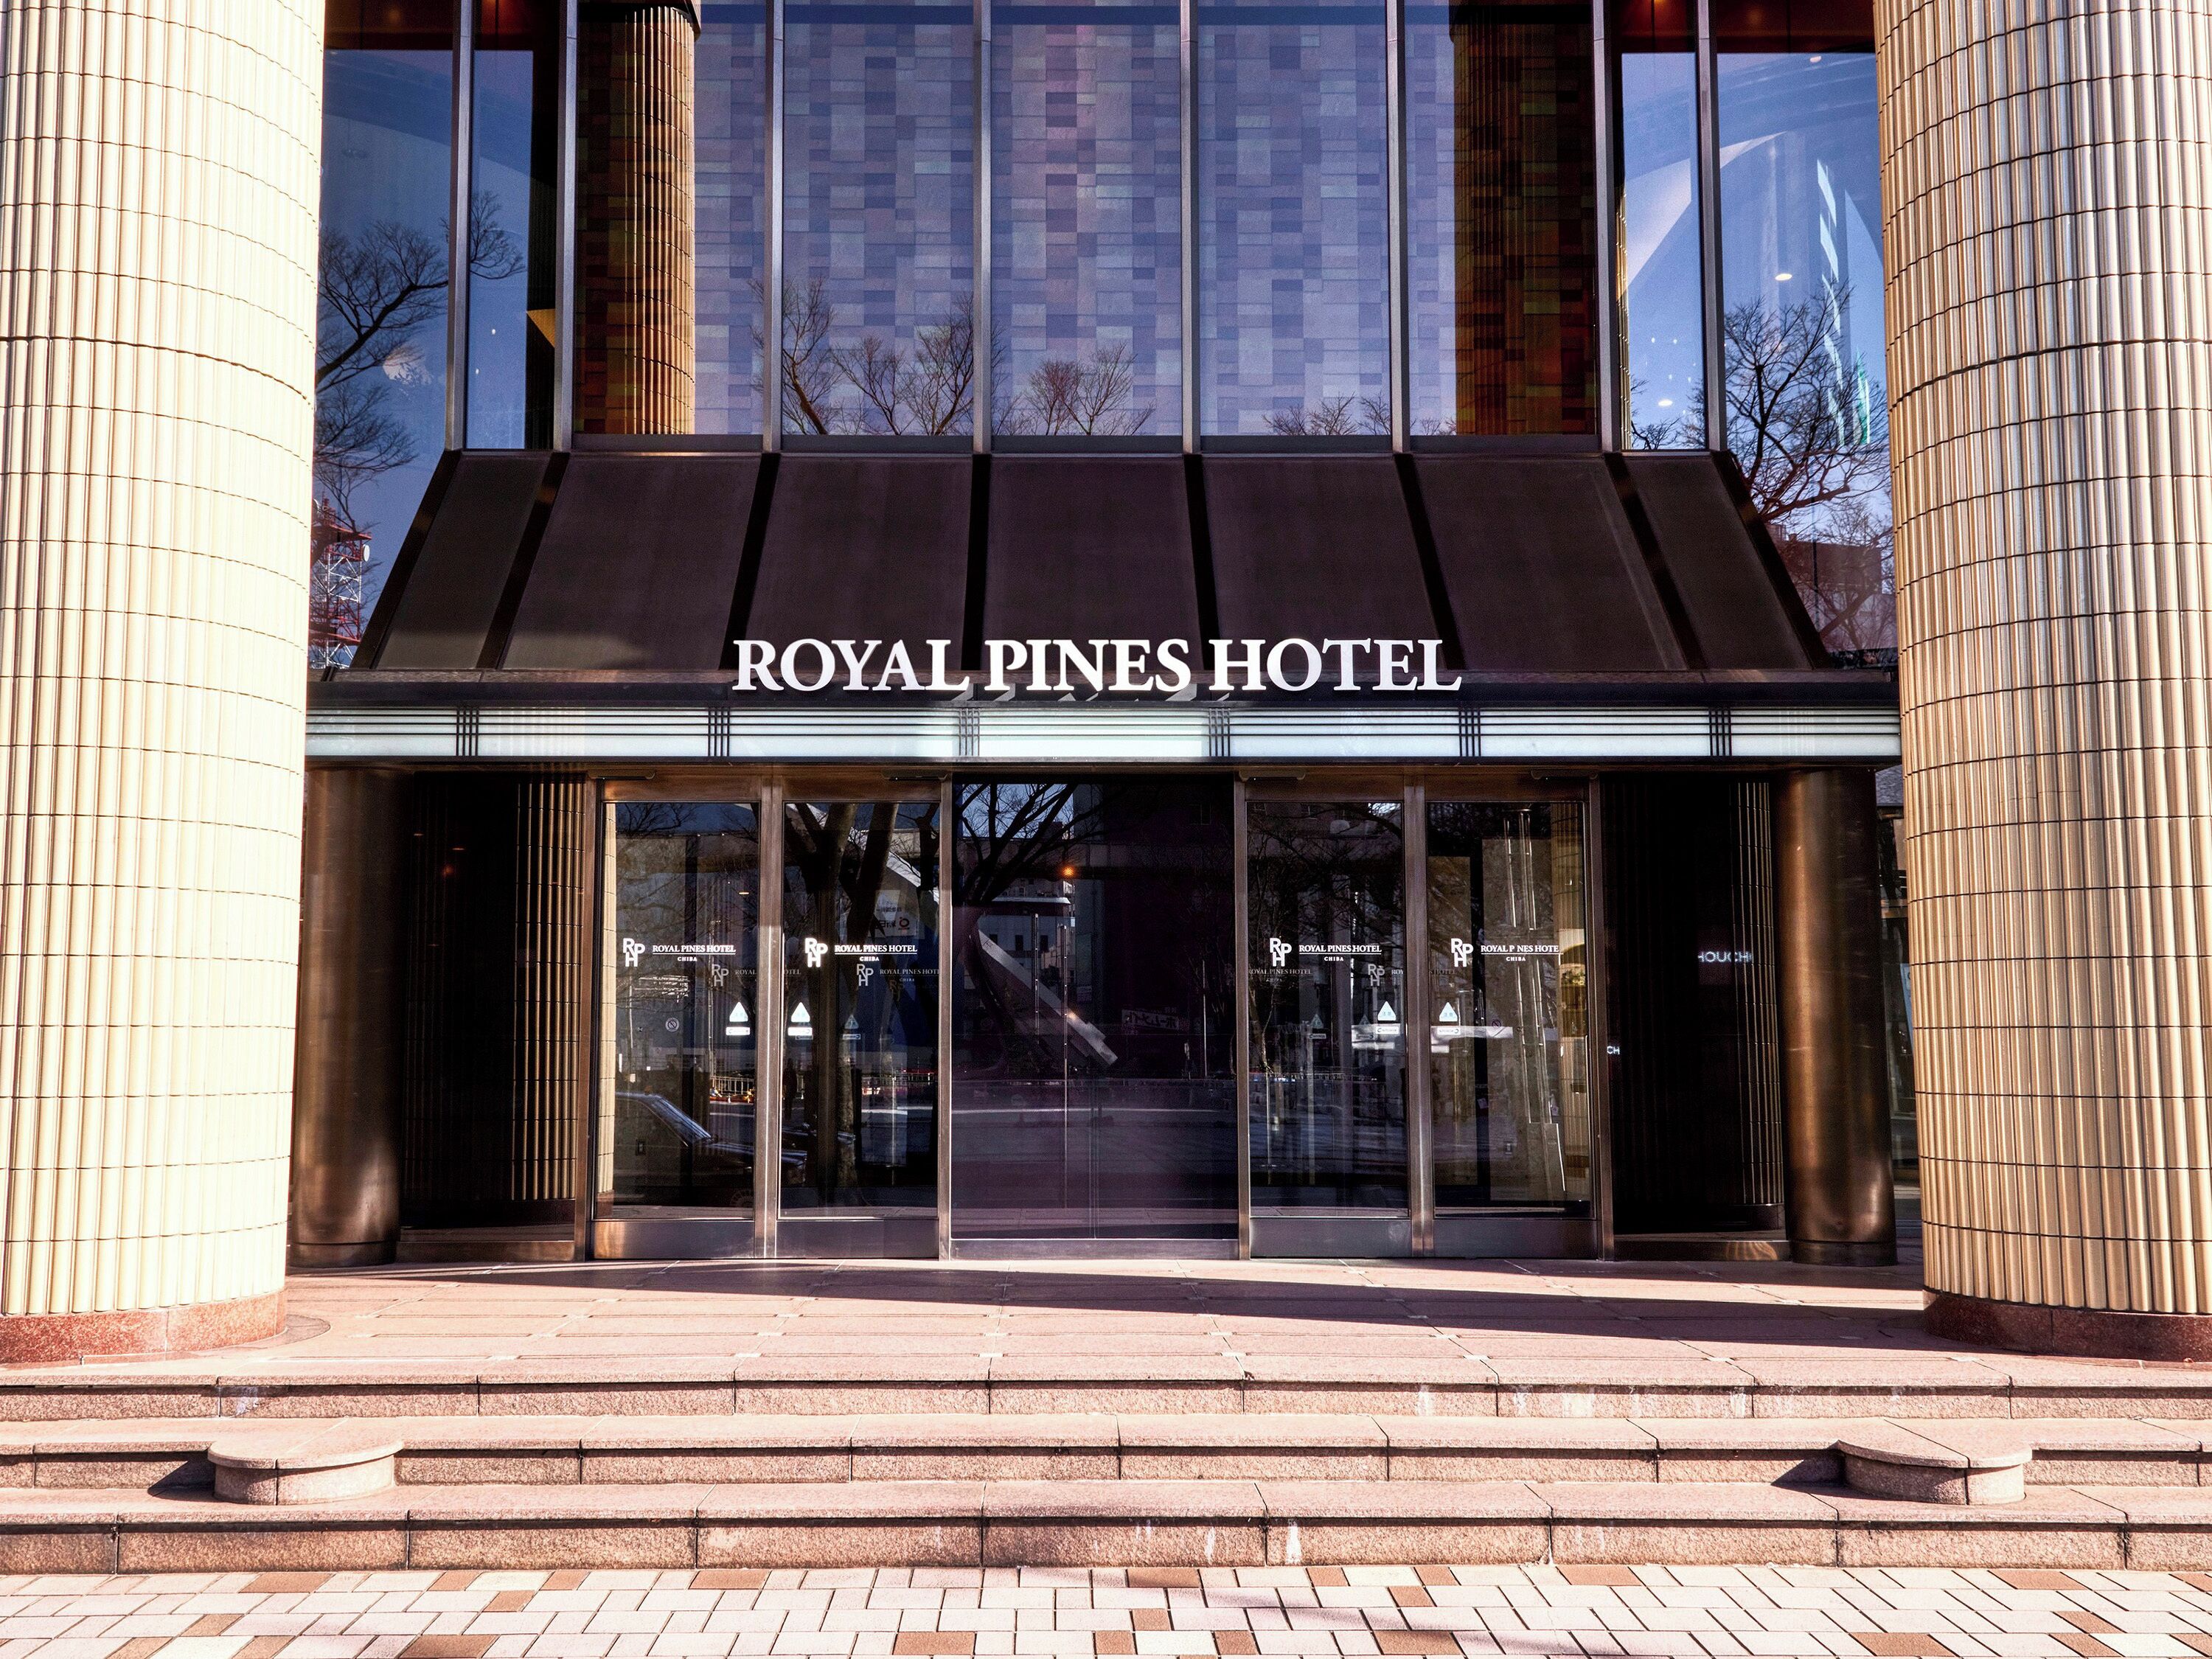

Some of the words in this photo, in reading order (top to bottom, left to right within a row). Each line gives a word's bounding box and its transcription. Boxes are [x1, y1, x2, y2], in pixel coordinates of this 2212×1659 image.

[731, 639, 970, 692] ROYAL
[983, 639, 1192, 693] PINES
[1208, 638, 1463, 692] HOTEL
[652, 945, 680, 953] ROYAL
[681, 945, 706, 953] PINES
[706, 945, 737, 953] HOTEL
[834, 945, 863, 953] ROYAL
[863, 945, 888, 953] PINES
[888, 945, 918, 953] HOTEL
[1298, 945, 1325, 953] ROYAL
[1327, 945, 1352, 953] PINES
[1352, 945, 1382, 953] HOTEL
